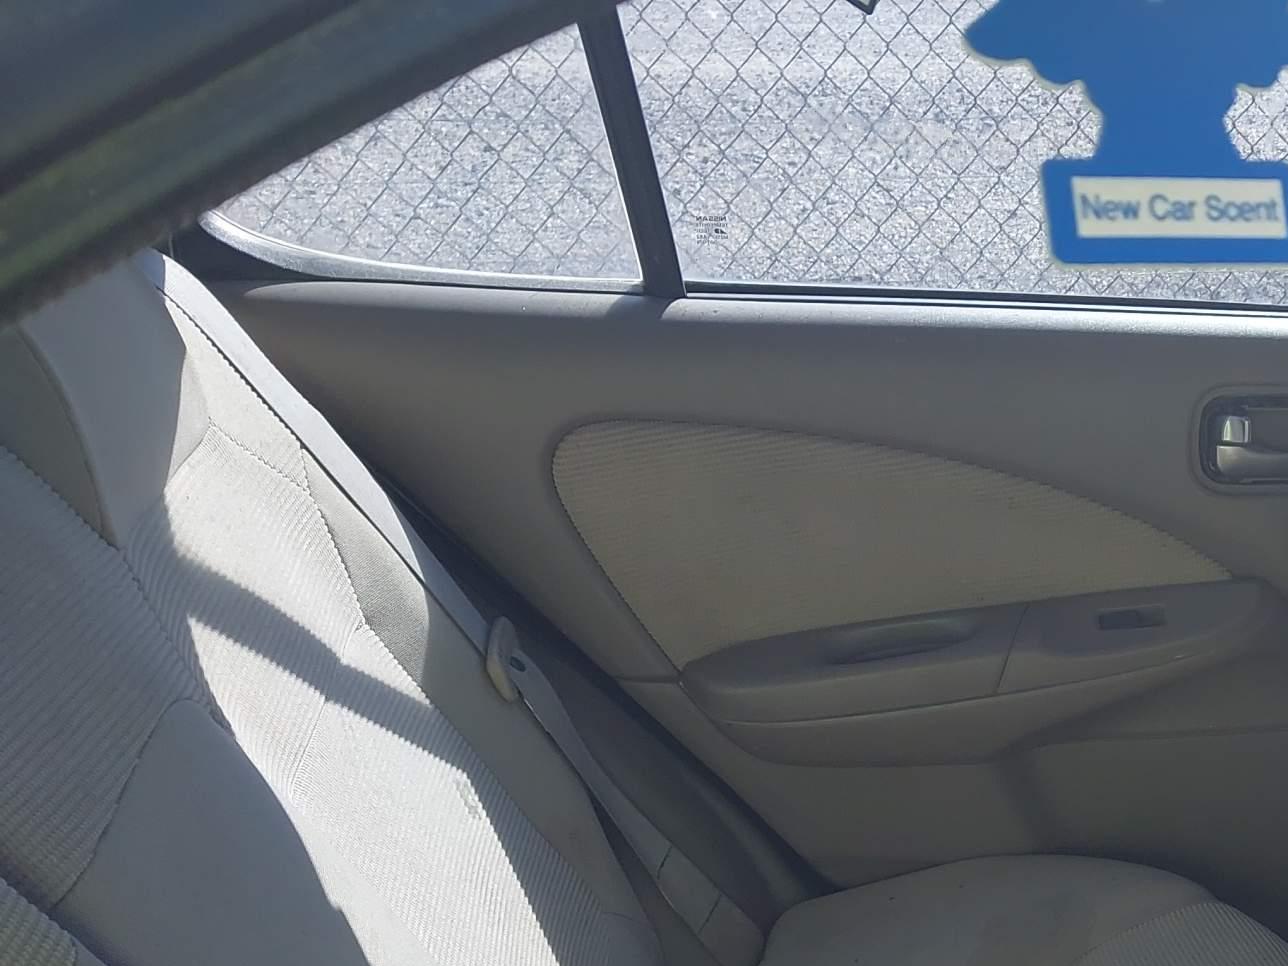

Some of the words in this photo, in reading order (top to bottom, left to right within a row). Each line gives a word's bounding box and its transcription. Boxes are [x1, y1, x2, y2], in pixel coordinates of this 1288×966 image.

[1080, 193, 1141, 221] New
[1148, 192, 1197, 222] Car
[1204, 193, 1280, 222] Scent
